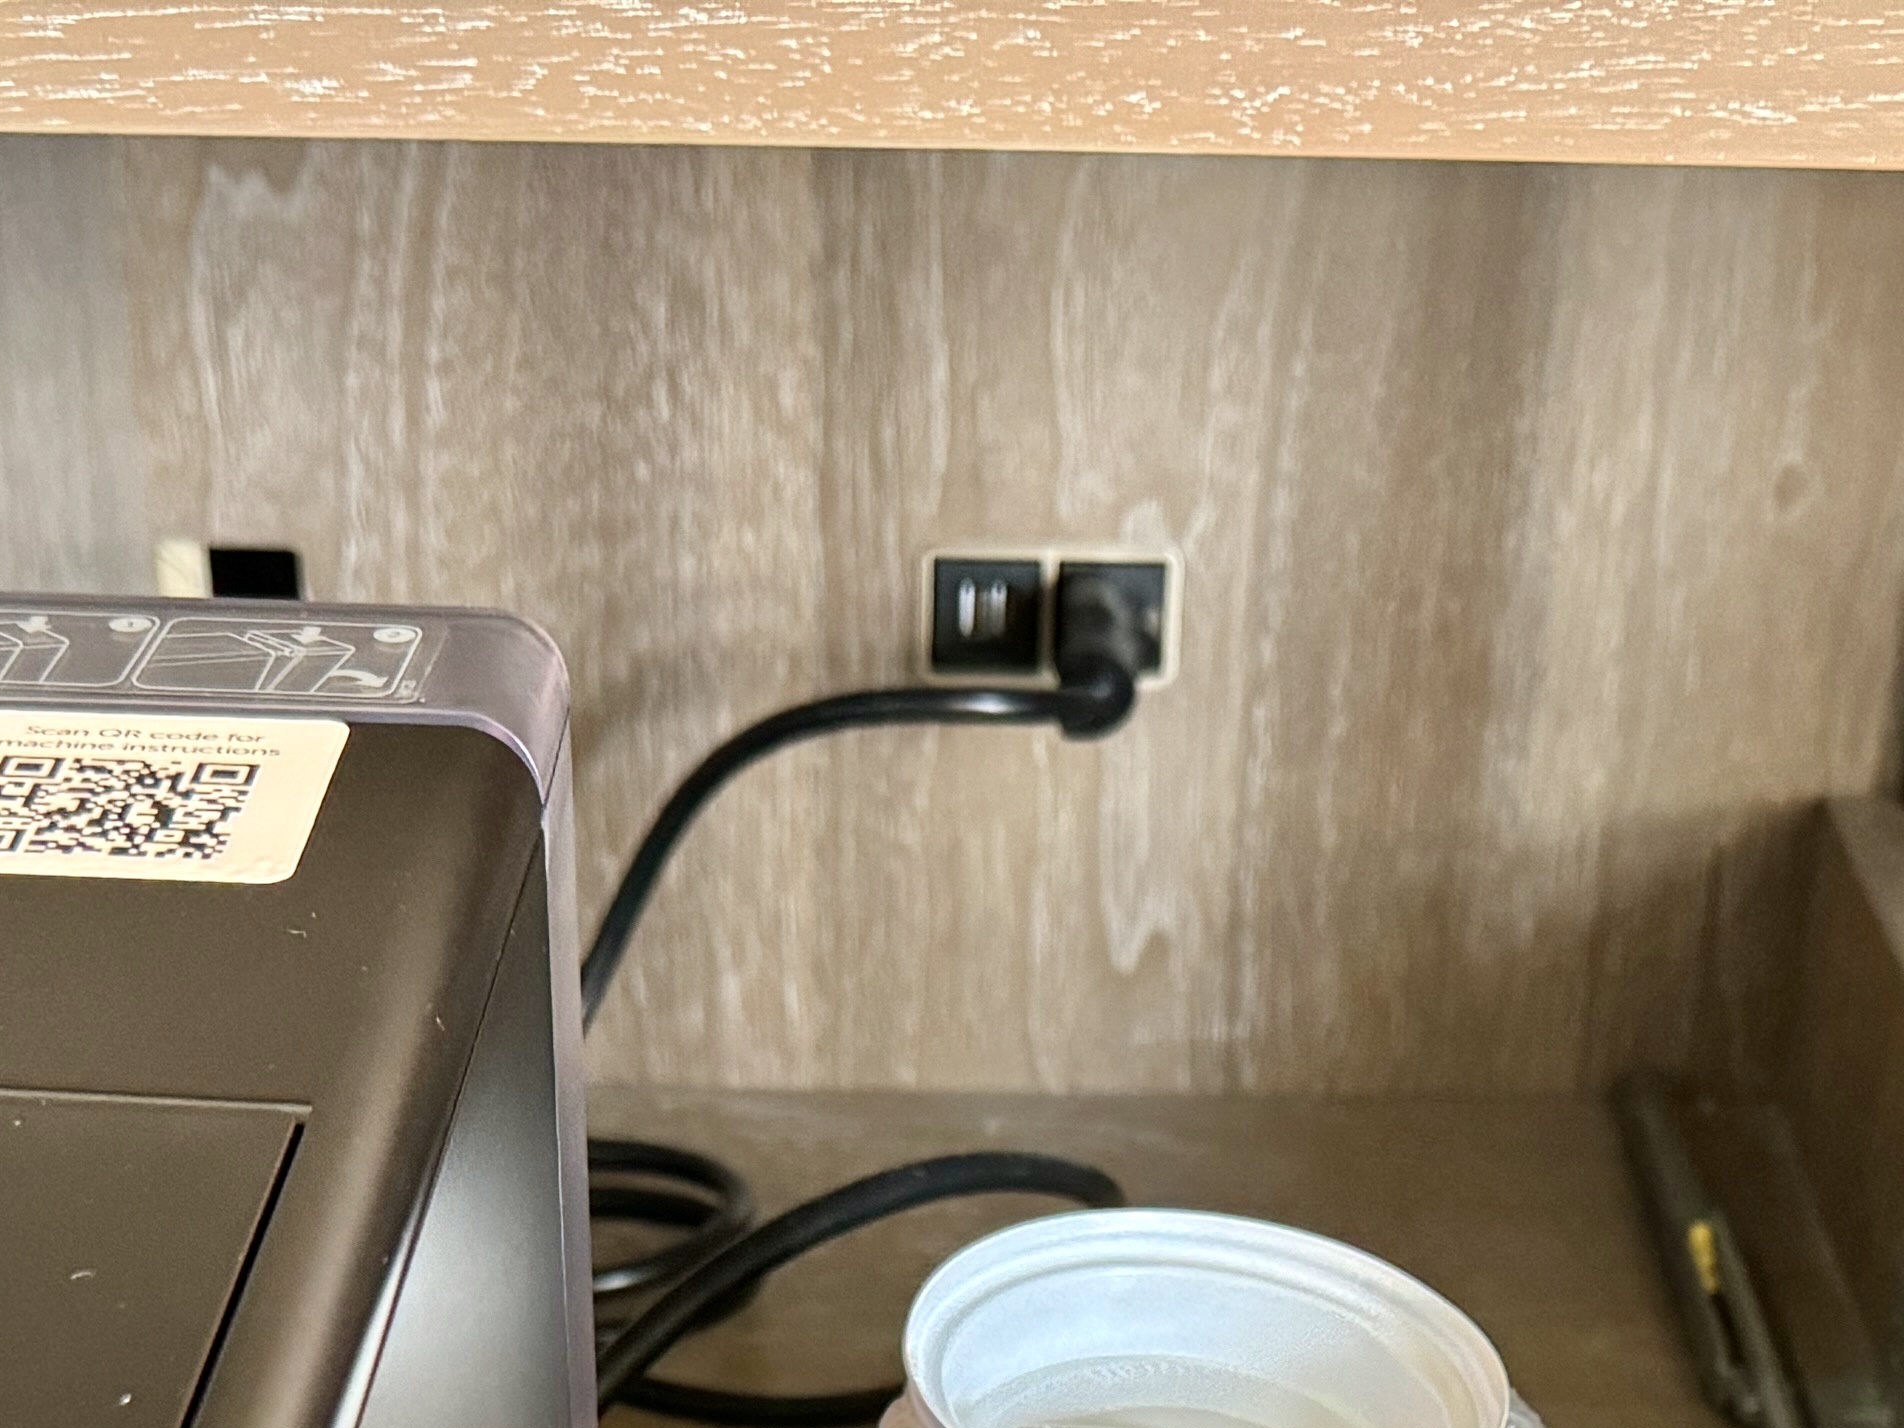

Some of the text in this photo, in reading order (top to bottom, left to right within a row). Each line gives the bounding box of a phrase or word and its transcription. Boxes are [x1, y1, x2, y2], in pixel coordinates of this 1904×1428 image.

[25, 725, 266, 743] Scan QR code for
[122, 742, 280, 757] instructions
